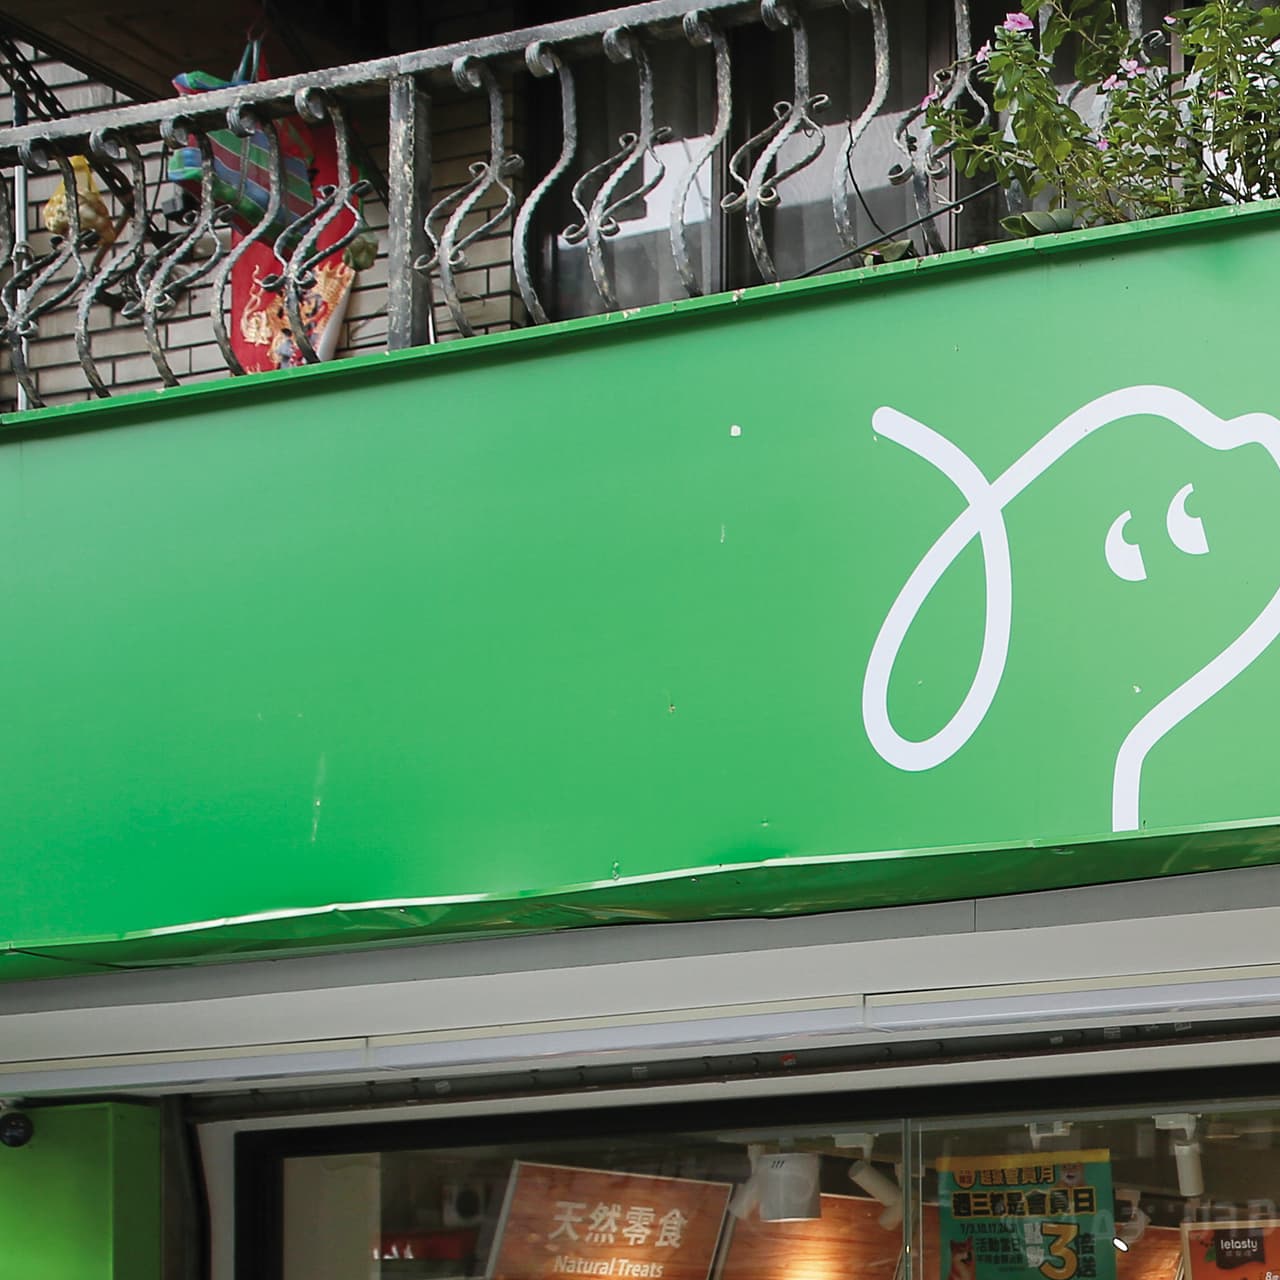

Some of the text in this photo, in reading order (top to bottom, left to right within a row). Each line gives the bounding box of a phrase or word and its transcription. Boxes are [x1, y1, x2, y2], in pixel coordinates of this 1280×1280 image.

[548, 1200, 690, 1249] 天然零食
[553, 1254, 665, 1280] Natural Treats
[1039, 1222, 1079, 1280] 3
